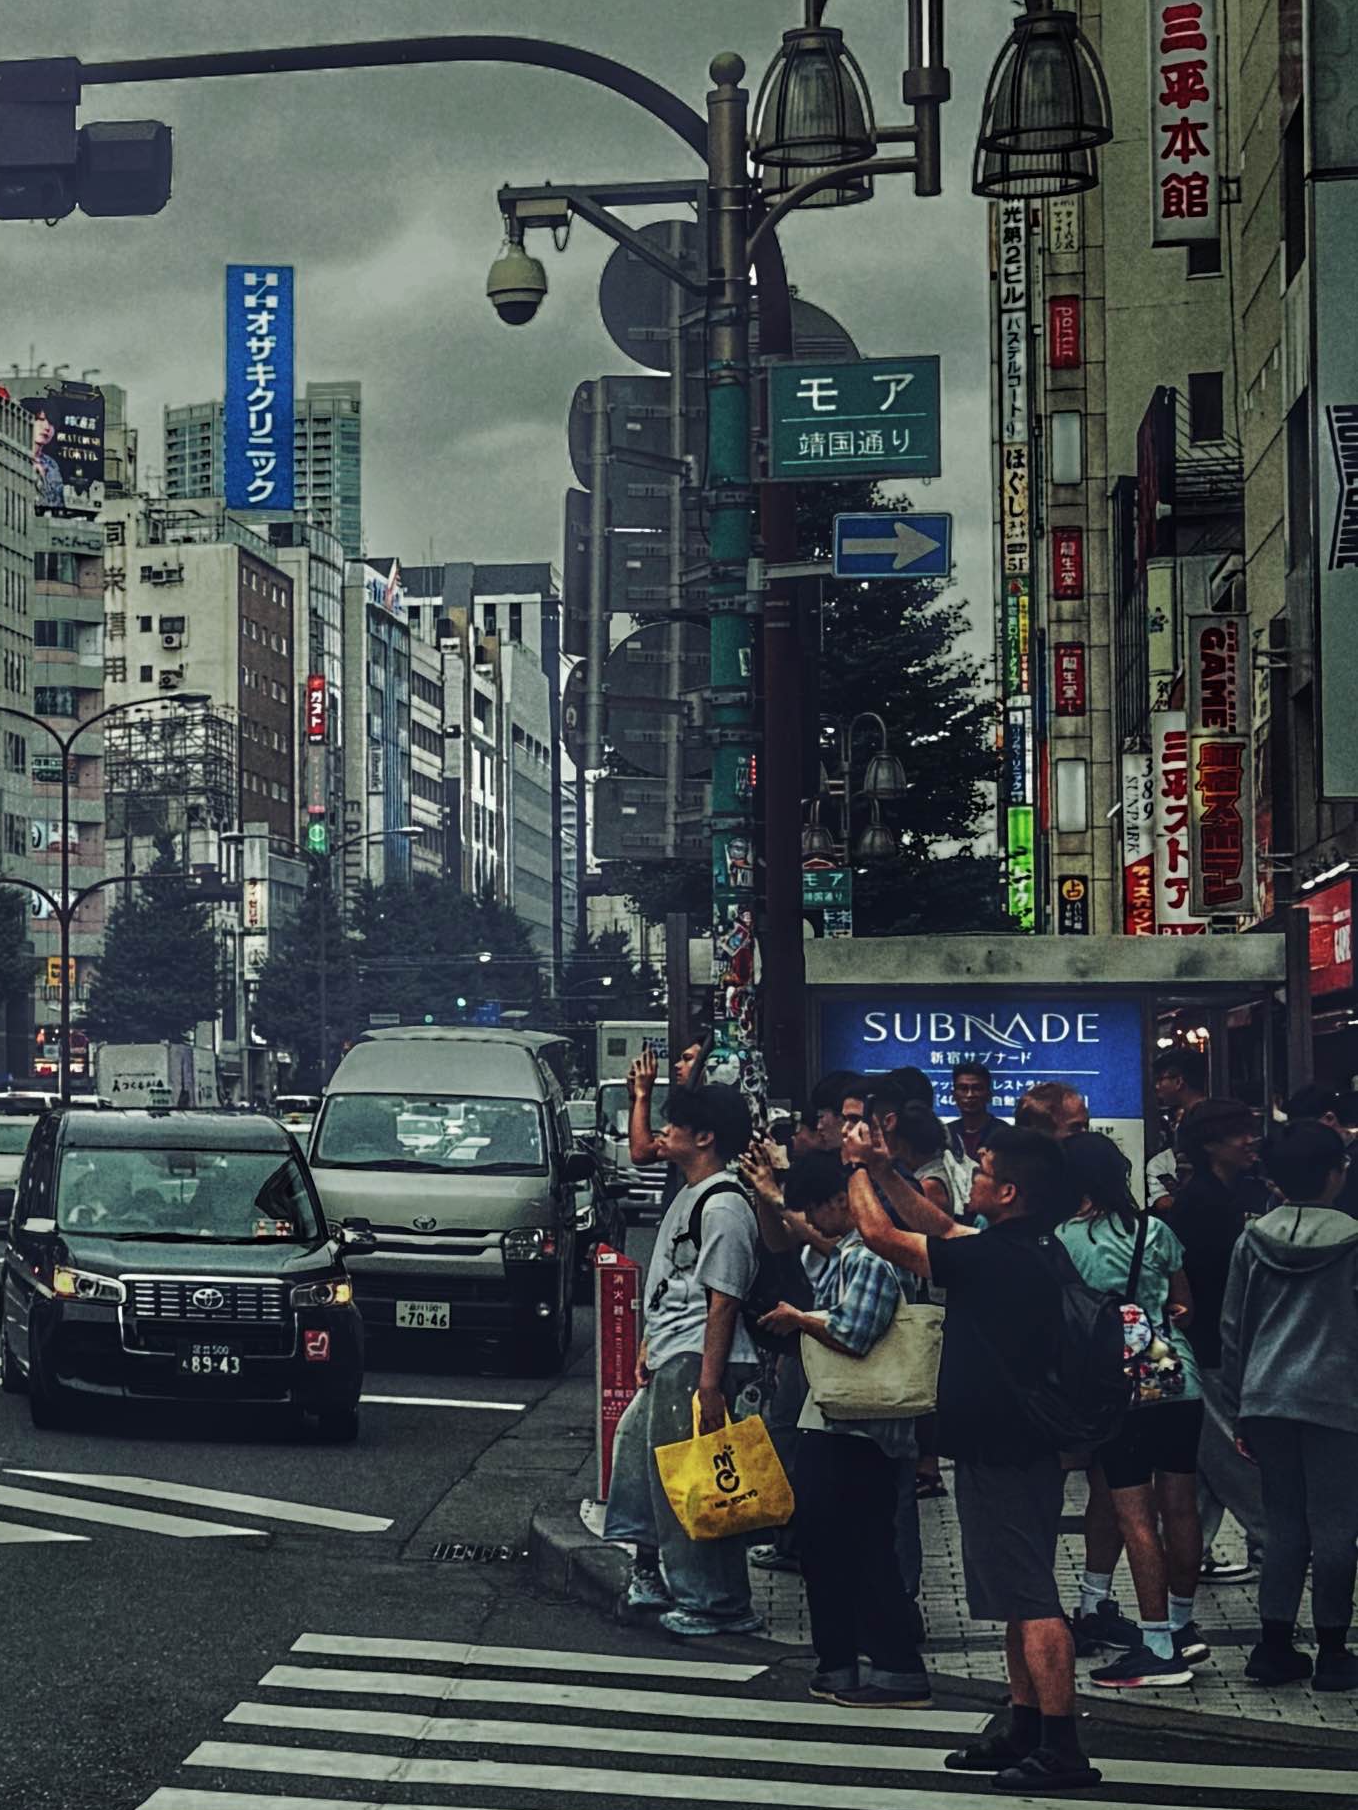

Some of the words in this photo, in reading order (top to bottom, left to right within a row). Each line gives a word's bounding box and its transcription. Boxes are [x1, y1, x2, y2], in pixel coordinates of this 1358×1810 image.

[1156, 0, 1210, 223] 三平本館
[1002, 200, 1026, 305] 光第2ビル
[244, 311, 277, 504] オザキクリニック
[796, 373, 915, 412] モア
[798, 428, 911, 459] 靖国通り
[1199, 627, 1228, 731] GAME
[1141, 757, 1154, 820] 389
[862, 1011, 1101, 1049] SUBNADE
[929, 1050, 1033, 1066] 新宿サブナード
[191, 1356, 241, 1374] 89-43
